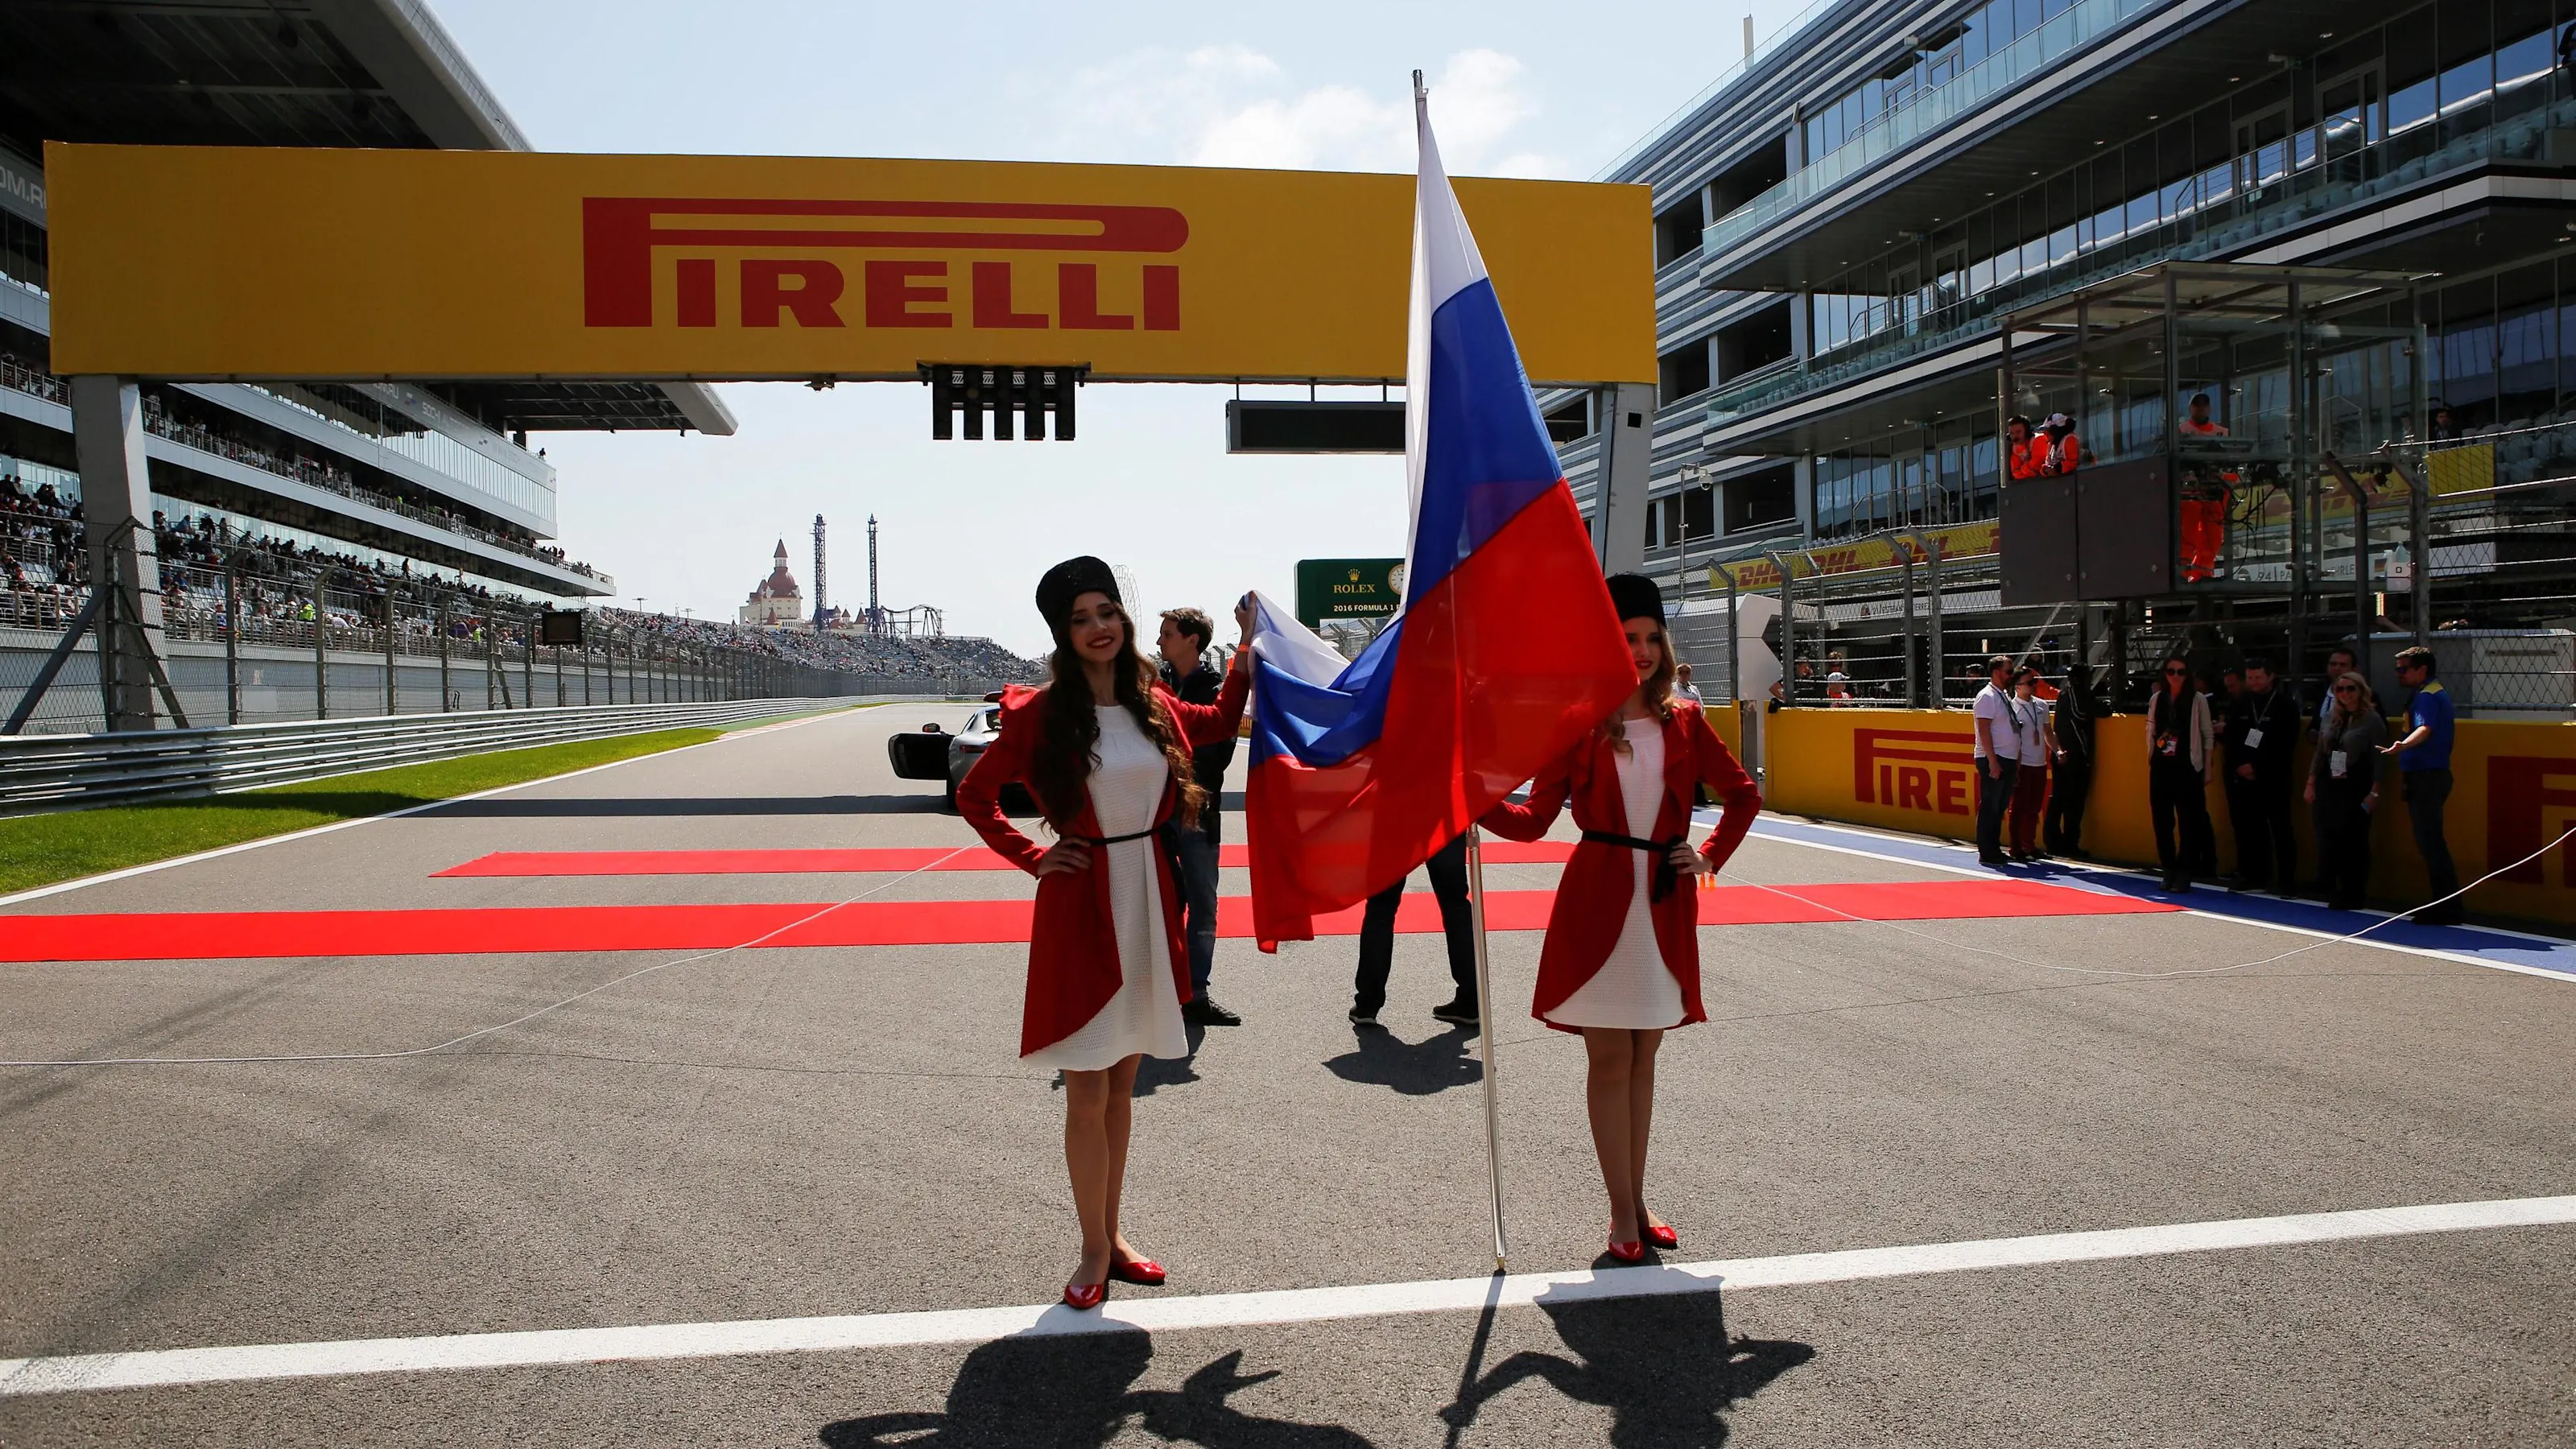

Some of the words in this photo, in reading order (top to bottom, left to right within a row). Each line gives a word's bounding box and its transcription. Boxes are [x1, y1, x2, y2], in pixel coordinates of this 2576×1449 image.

[583, 196, 1189, 331] PIRELLI
[1738, 563, 1782, 587] DHL
[1809, 550, 1861, 576] DHL
[1333, 584, 1375, 593] ROLEX
[1854, 728, 1980, 817] PIRE
